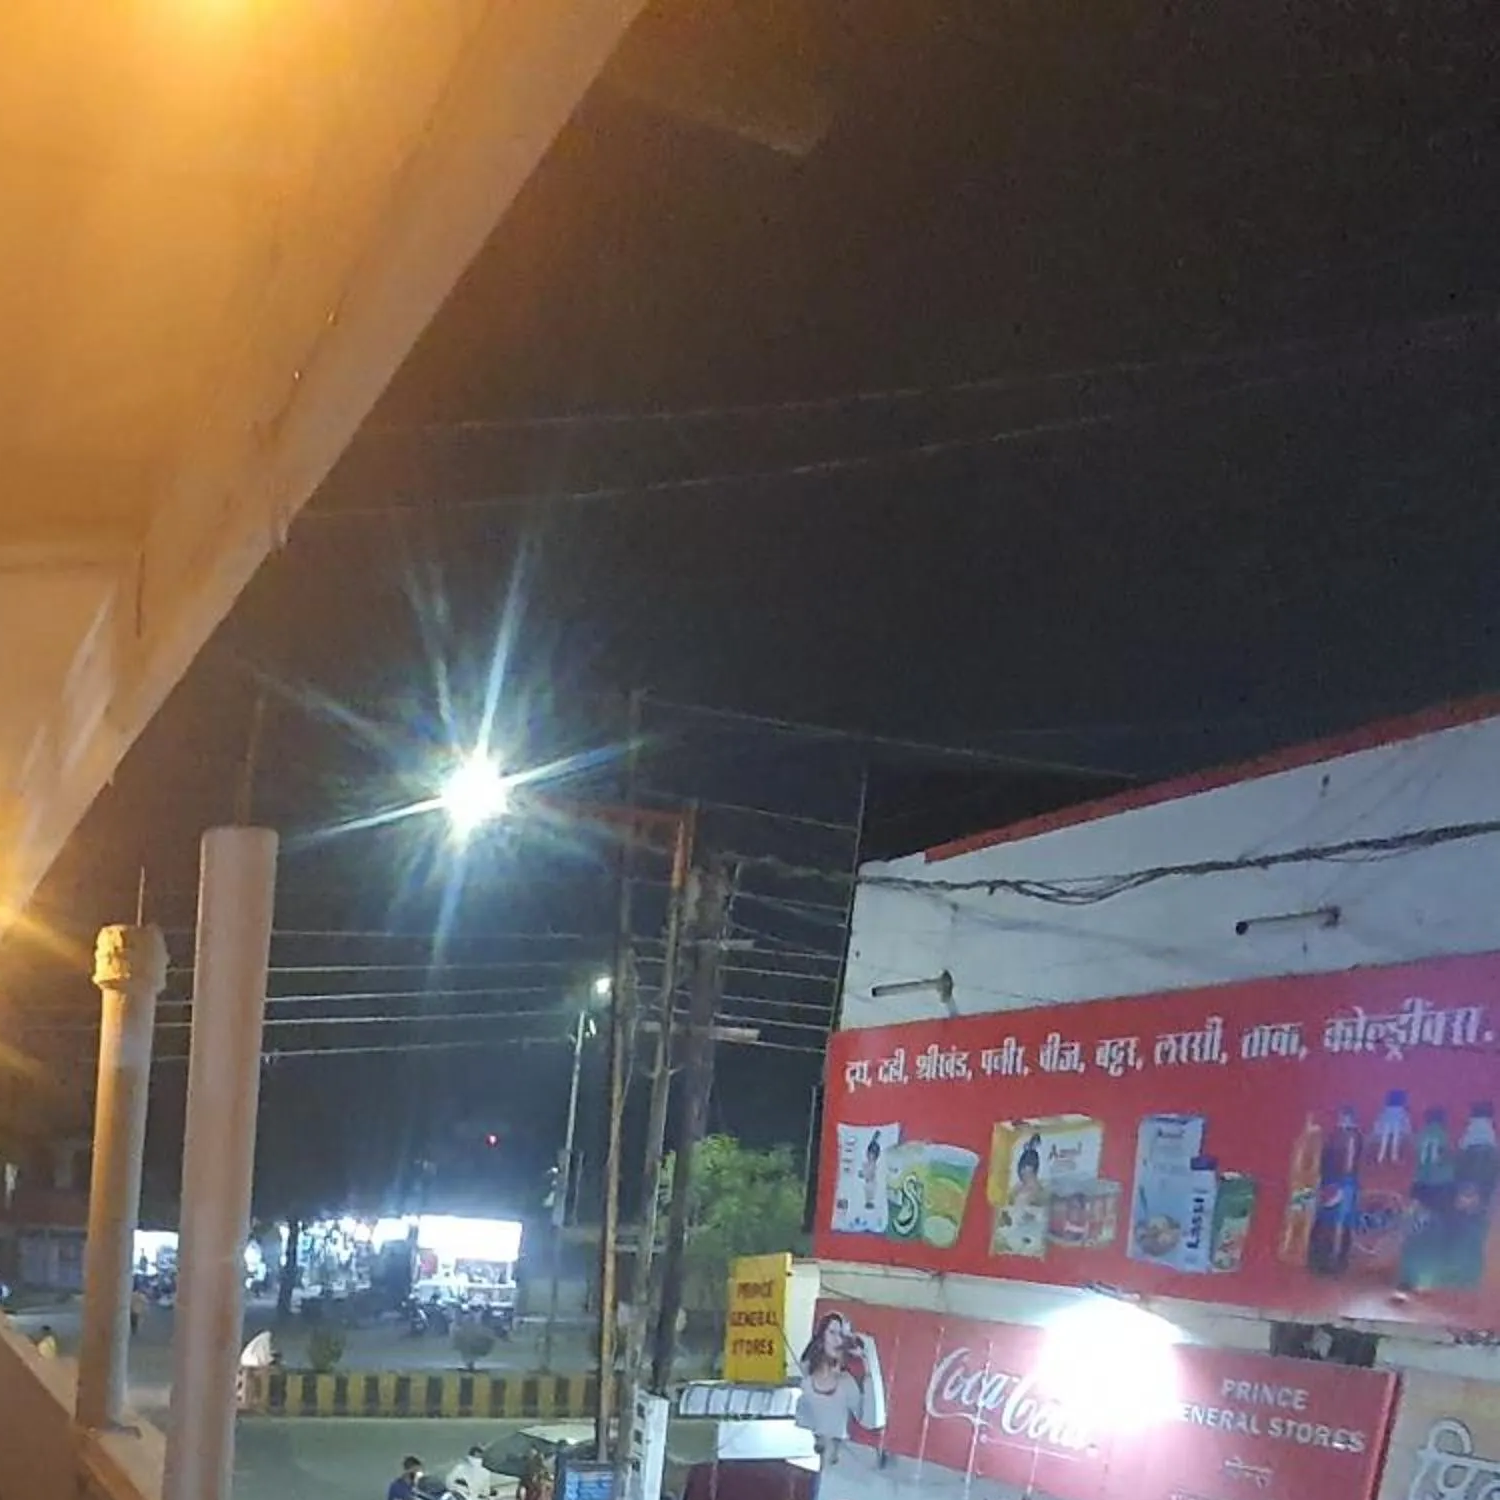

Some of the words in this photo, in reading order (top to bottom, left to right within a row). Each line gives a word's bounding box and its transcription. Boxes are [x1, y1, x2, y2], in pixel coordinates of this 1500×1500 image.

[1221, 1378, 1310, 1411] PRINCE
[1178, 1402, 1262, 1435] ENERAL
[1267, 1416, 1367, 1453] STORES
